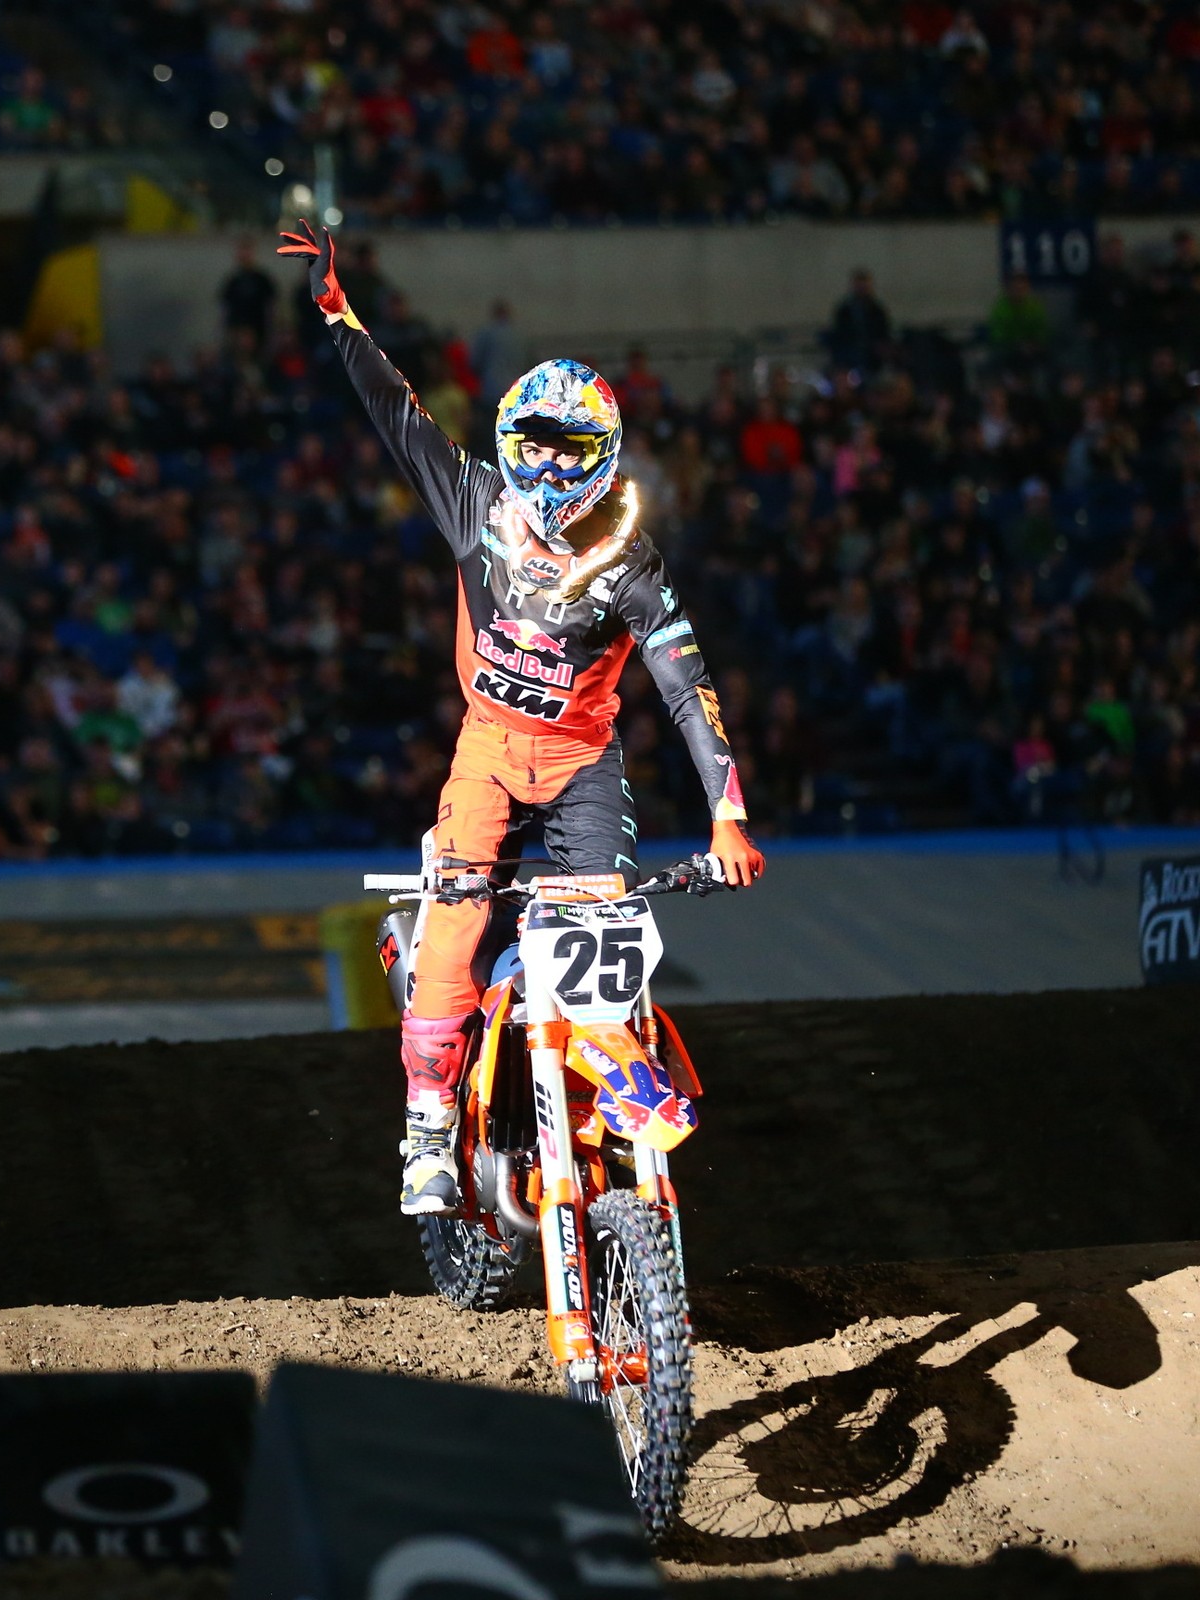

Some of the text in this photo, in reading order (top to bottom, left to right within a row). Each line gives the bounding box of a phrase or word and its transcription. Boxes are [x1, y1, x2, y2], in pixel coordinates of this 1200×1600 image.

[1008, 229, 1091, 276] 110
[526, 558, 561, 578] KTM
[474, 672, 567, 721] KTM
[553, 927, 644, 1006] 25
[560, 1206, 583, 1311] DUNOP
